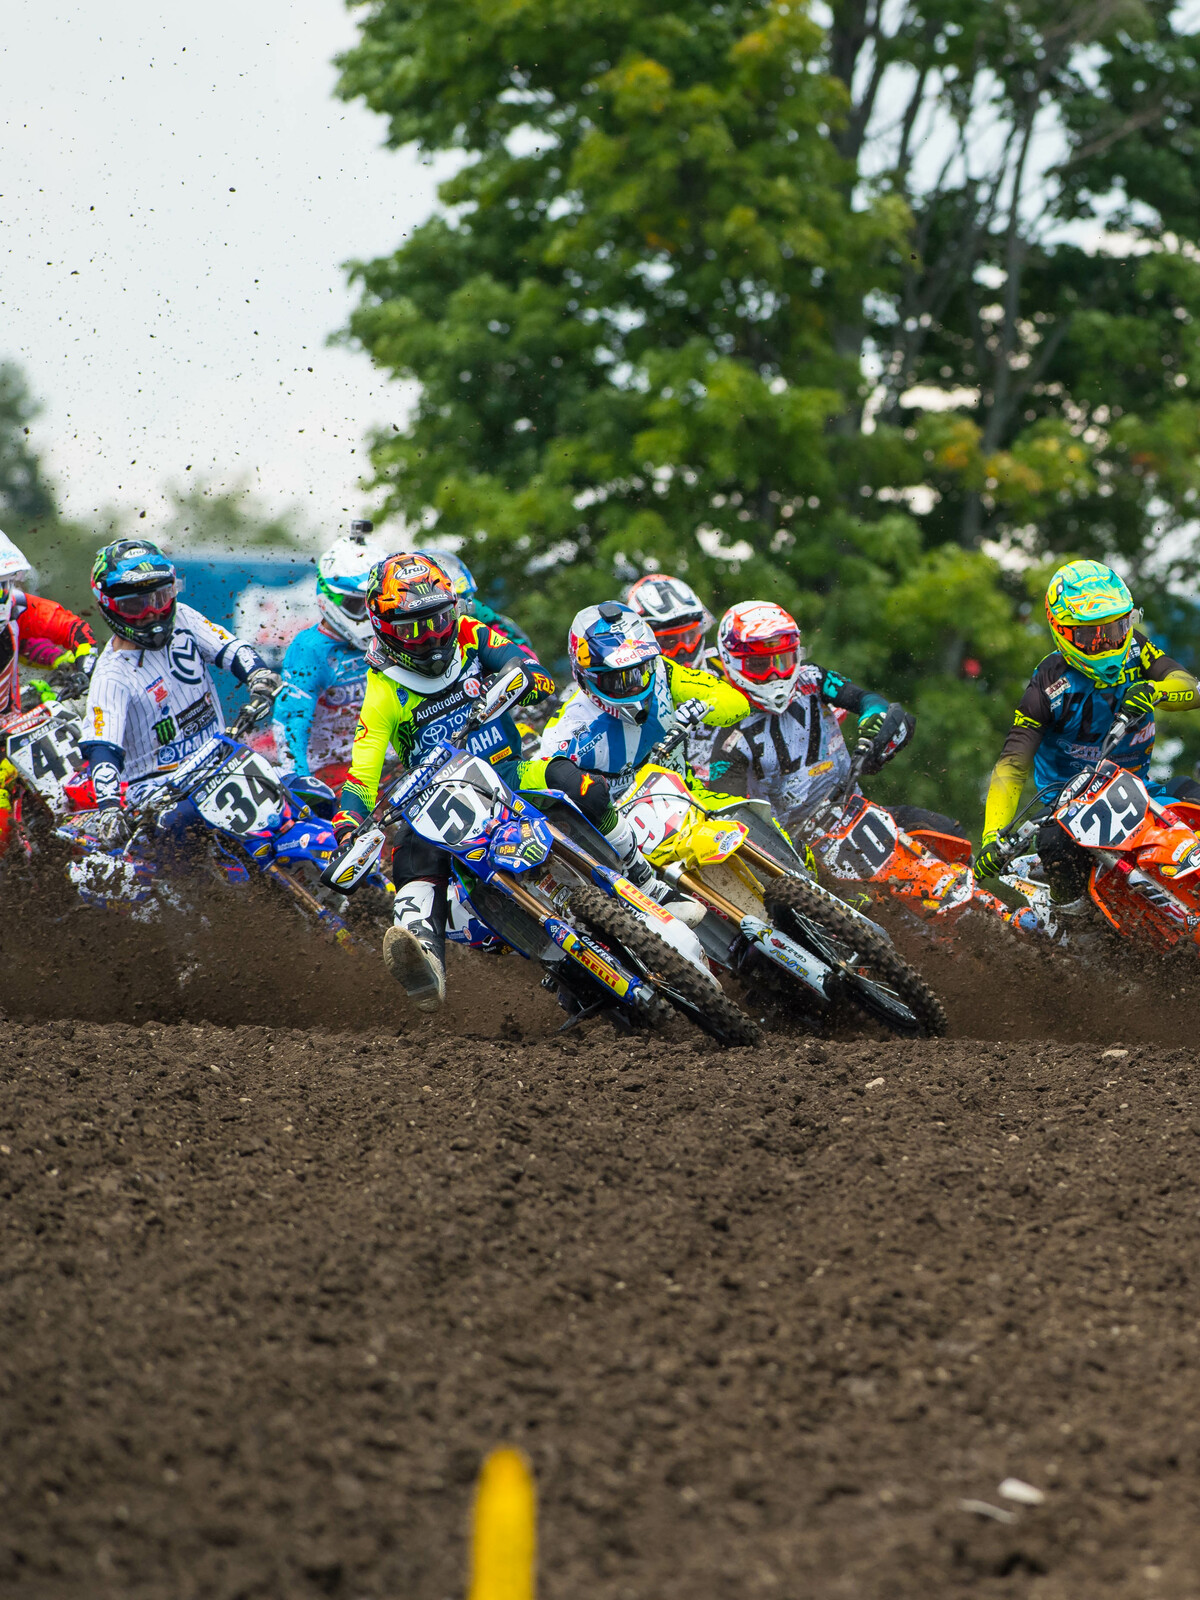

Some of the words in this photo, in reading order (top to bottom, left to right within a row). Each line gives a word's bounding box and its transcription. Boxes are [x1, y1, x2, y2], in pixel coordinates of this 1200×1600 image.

[402, 565, 424, 576] Arai
[421, 593, 449, 602] TOYOTA
[615, 651, 638, 666] Red
[636, 646, 660, 657] Bull
[416, 690, 464, 722] Autotrader
[1168, 690, 1194, 702] BTO
[29, 726, 50, 742] LUCAS
[175, 720, 219, 759] YAMAHA
[577, 733, 603, 757] SUZUKI
[491, 748, 510, 763] PIRELLI
[205, 768, 230, 794] LUCAS
[227, 757, 242, 773] OIL
[418, 776, 442, 807] LUCAS
[442, 763, 459, 779] OIL
[638, 785, 648, 797] OIL
[1091, 780, 1103, 793] OIL
[216, 760, 280, 834] 34
[1080, 771, 1149, 847] 29
[515, 837, 536, 857] YAMAHA
